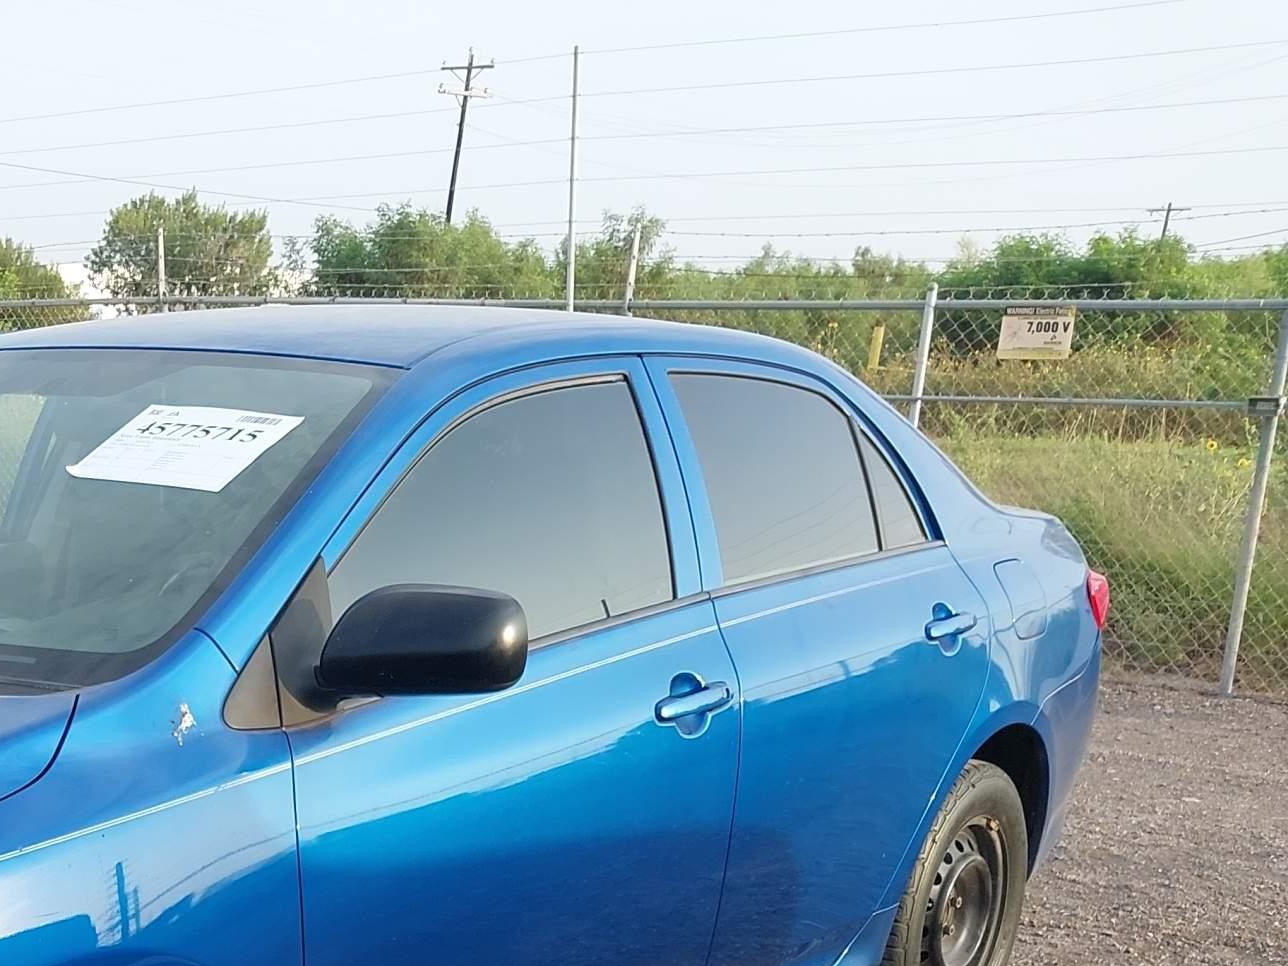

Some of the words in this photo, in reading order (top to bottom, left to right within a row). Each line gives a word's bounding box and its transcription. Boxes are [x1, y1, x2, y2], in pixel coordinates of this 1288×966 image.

[1027, 321, 1059, 335] 7,000
[1063, 321, 1071, 333] V
[136, 420, 265, 443] 45775715
